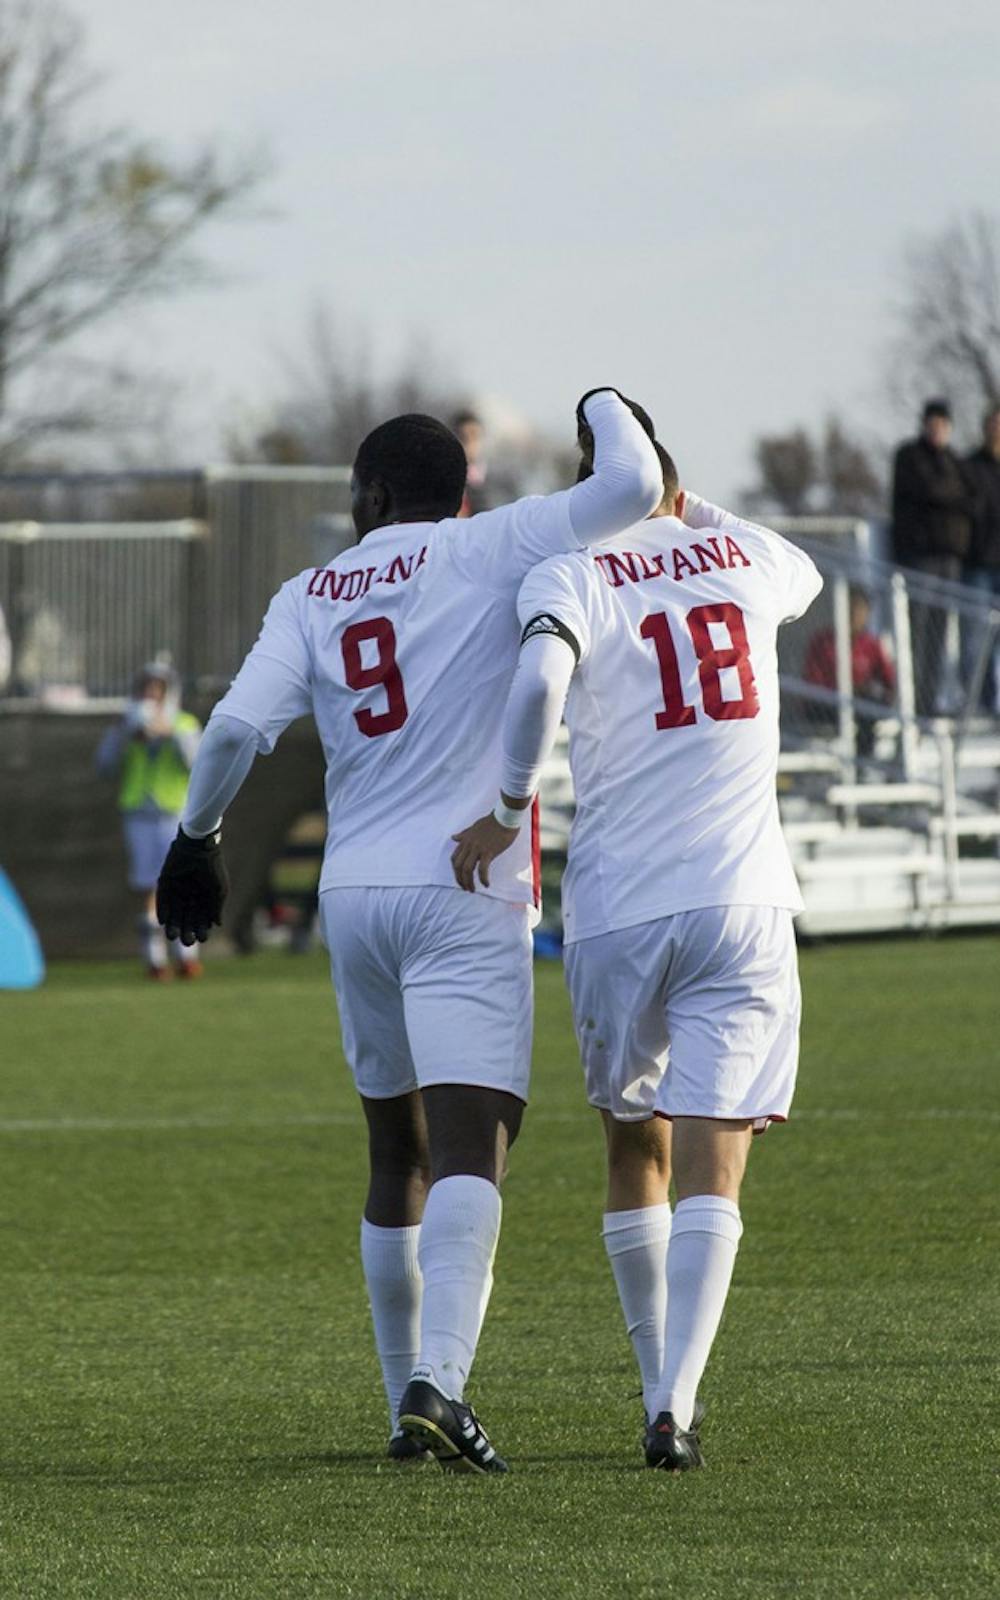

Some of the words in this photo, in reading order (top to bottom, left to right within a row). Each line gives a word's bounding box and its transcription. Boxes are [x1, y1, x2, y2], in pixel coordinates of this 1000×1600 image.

[307, 545, 427, 602] INDIN
[340, 616, 409, 738] 9
[640, 602, 760, 731] 18
